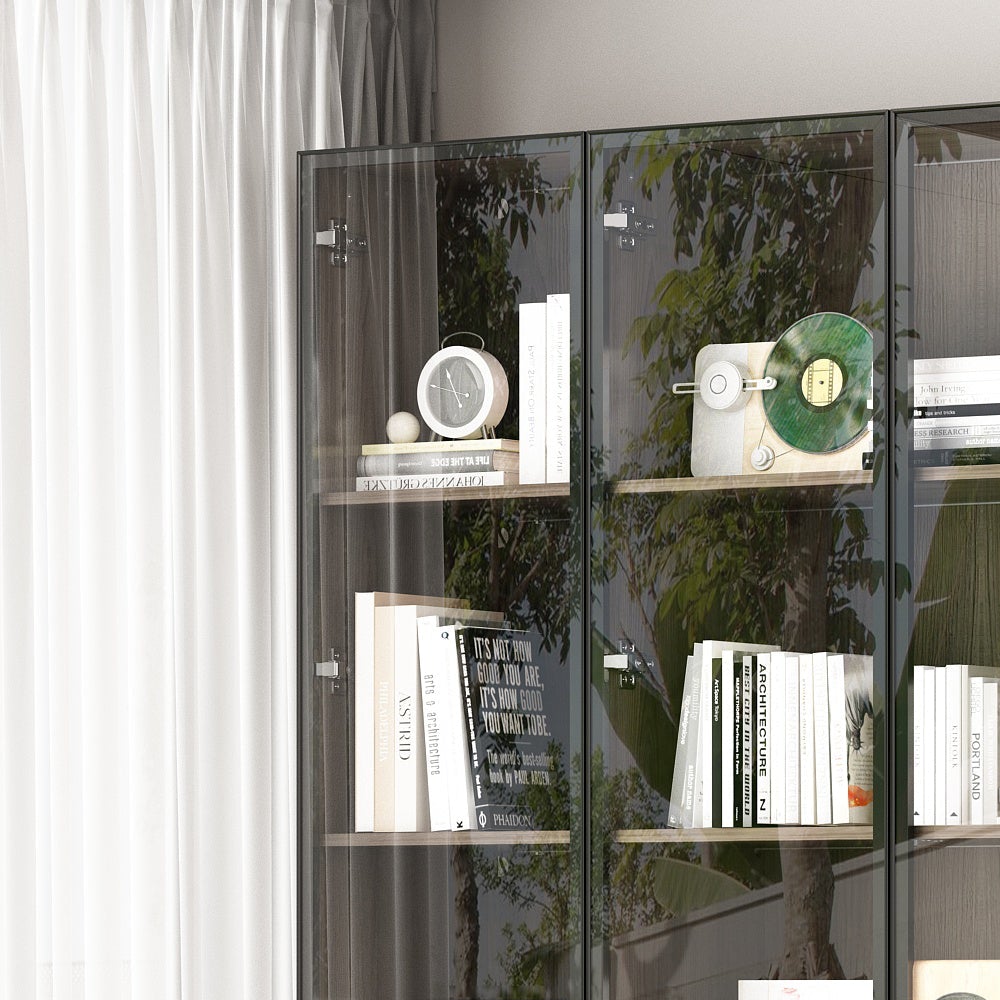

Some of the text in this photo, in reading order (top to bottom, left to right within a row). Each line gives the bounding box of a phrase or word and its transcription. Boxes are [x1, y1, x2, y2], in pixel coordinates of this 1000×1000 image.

[920, 385, 939, 395] John
[928, 428, 969, 437] RESEARCH
[441, 631, 449, 640] Q
[474, 637, 532, 663] IT'S NOT HOW
[424, 674, 434, 695] arts
[477, 661, 545, 690] GOOD YOU ARE,
[480, 686, 543, 712] IT'S HOW GOOD
[379, 681, 389, 762] PHILADELPHIA
[399, 693, 411, 761] ASTRID
[482, 711, 500, 734] YOU
[500, 711, 525, 736] WANT
[759, 663, 767, 777] ARCHITECTURE
[427, 712, 441, 776] architecture
[486, 749, 498, 765] The
[971, 732, 981, 801] PORTLAND
[489, 769, 504, 785] book
[504, 769, 513, 788] by
[514, 770, 530, 785] PAUL
[759, 798, 767, 812] N
[456, 820, 464, 829] K
[493, 813, 532, 827] PHAIDON
